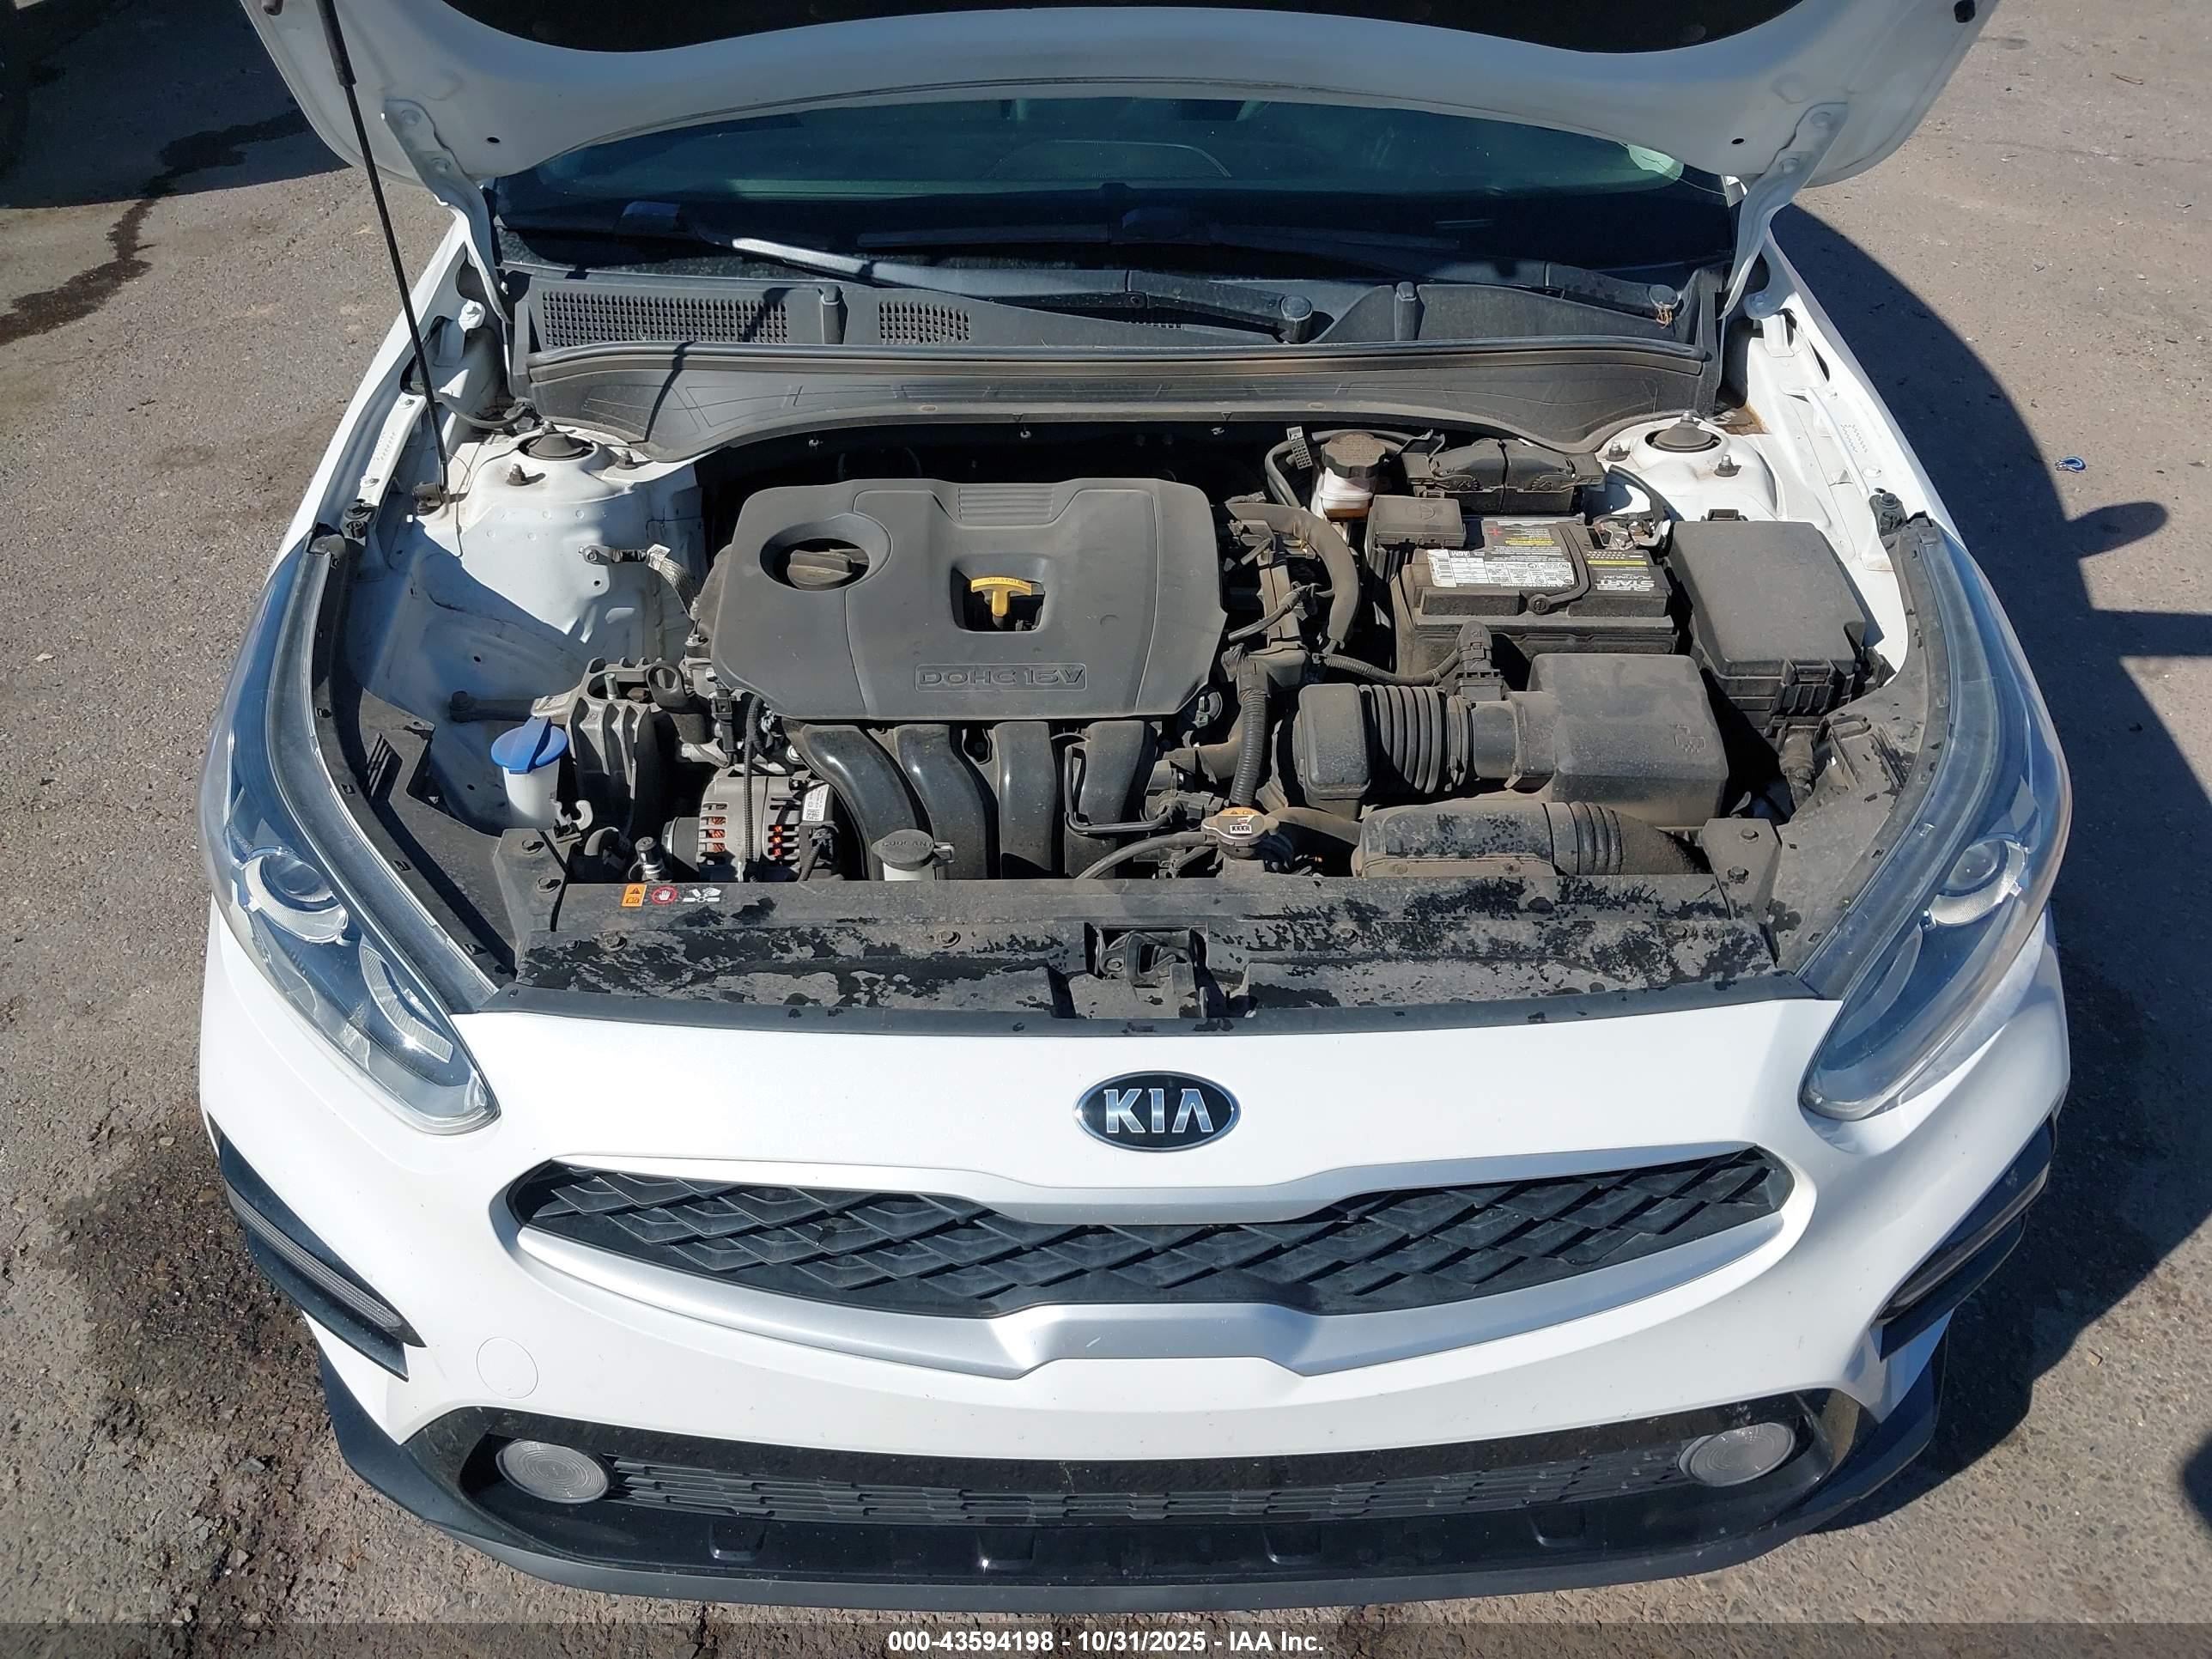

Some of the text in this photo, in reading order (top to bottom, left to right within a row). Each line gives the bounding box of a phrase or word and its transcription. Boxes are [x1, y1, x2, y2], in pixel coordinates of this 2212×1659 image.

[1595, 578, 1656, 587] START
[920, 668, 1085, 686] DOHC 16V
[1103, 1088, 1214, 1133] KIA
